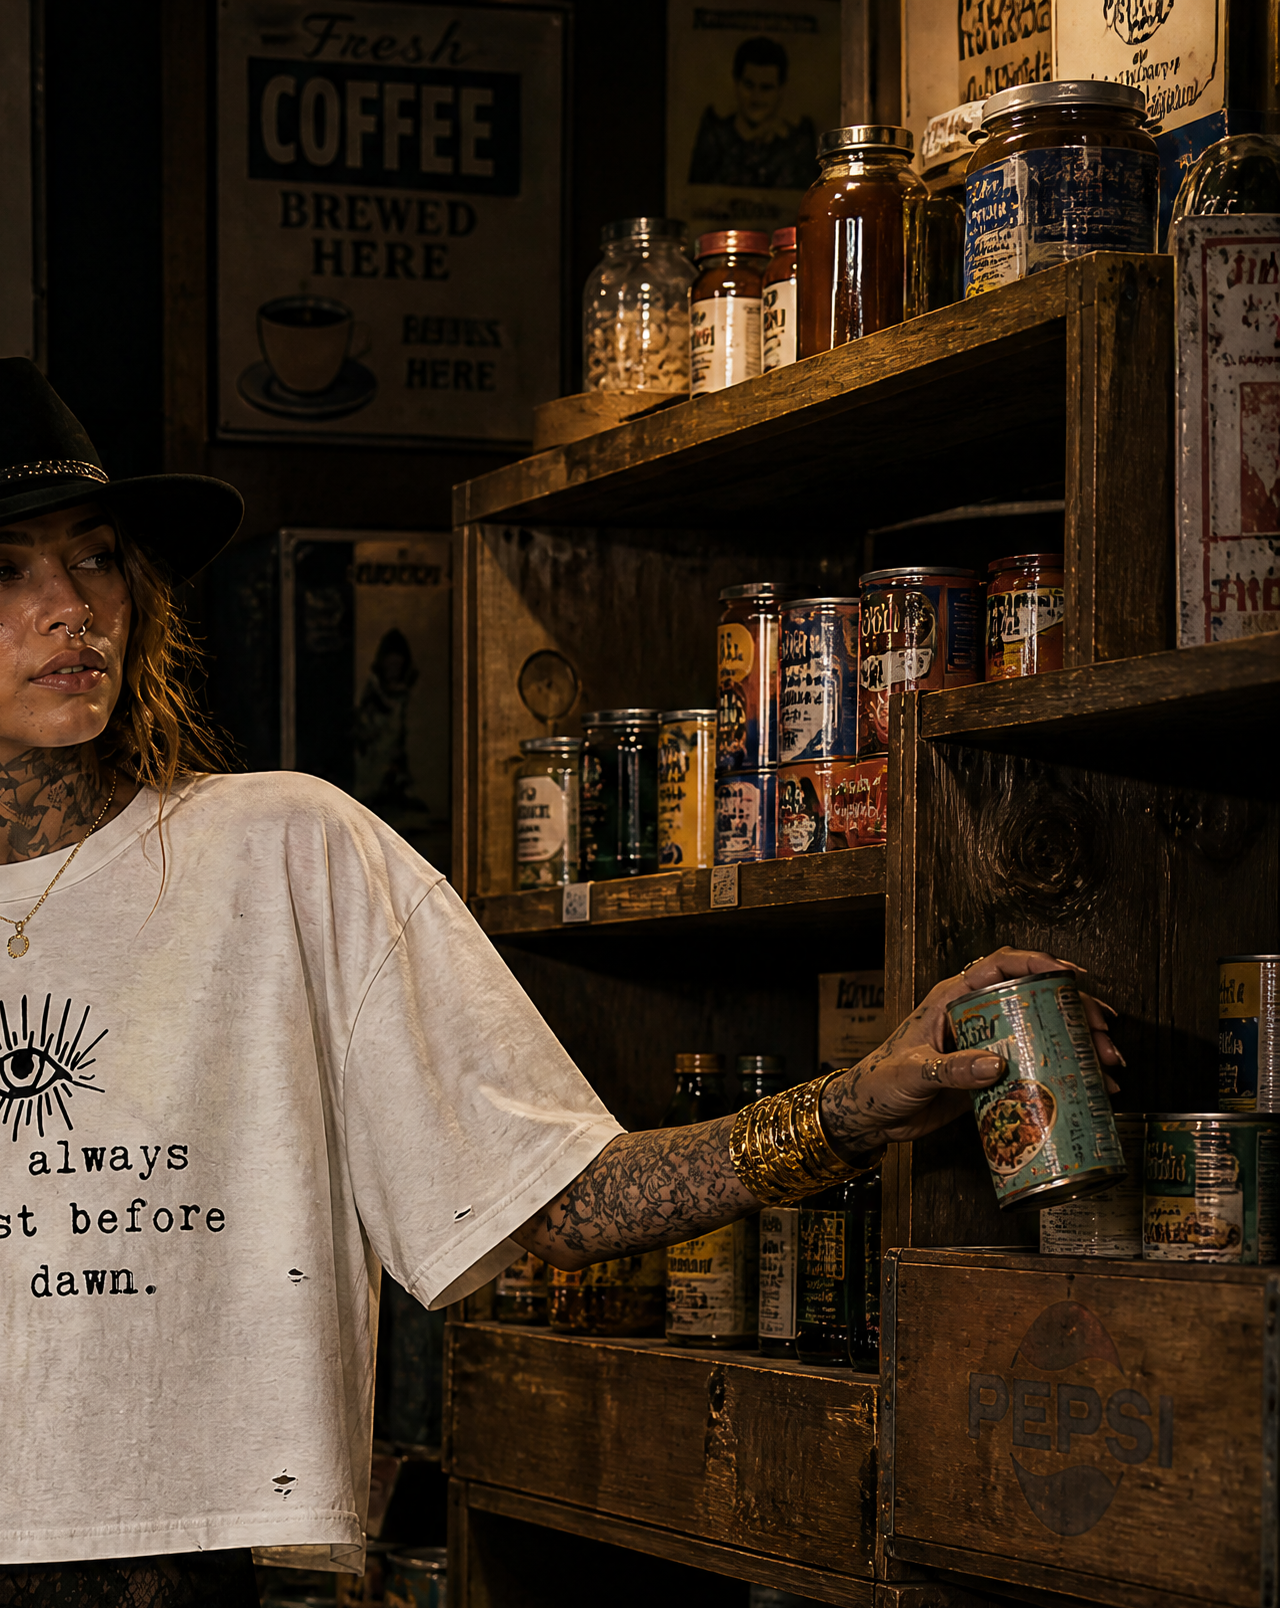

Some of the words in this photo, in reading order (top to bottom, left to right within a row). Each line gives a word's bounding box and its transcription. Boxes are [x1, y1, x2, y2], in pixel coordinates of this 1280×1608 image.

[303, 13, 469, 65] Fresh
[260, 73, 495, 178] COFFEE
[280, 191, 477, 237] BREWED
[312, 240, 451, 281] HERE
[405, 358, 497, 392] HERE
[28, 1141, 190, 1180] always
[70, 1198, 226, 1235] before
[31, 1265, 156, 1299] dawn.
[968, 1371, 1173, 1468] PEPSI
